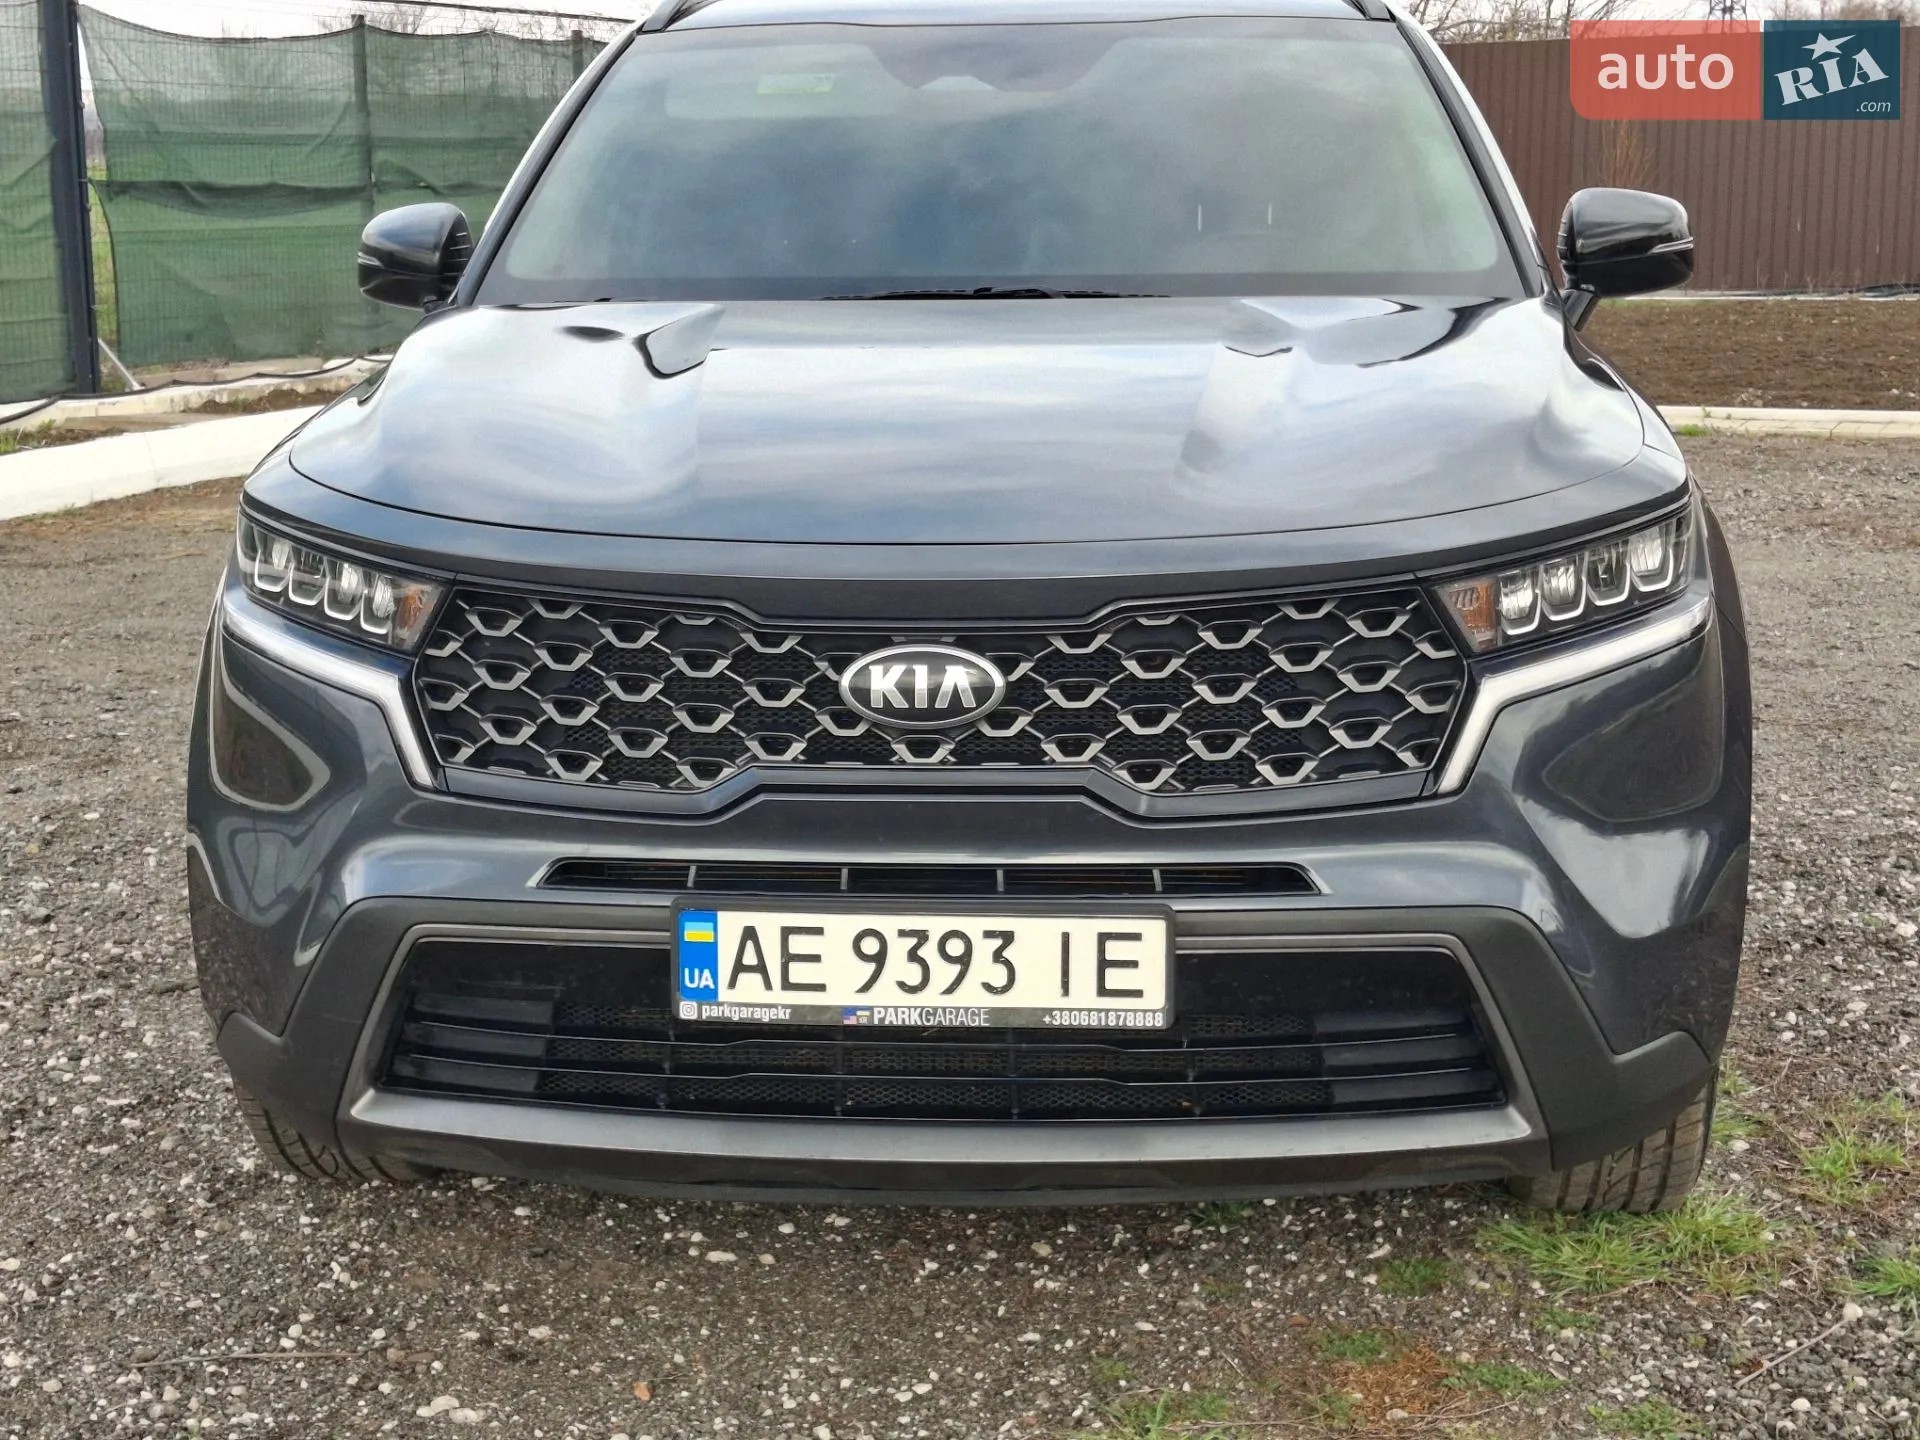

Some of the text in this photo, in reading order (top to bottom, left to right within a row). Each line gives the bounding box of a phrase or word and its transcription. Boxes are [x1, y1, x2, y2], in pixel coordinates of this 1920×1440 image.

[868, 665, 977, 709] KIA
[727, 925, 1145, 998] AE 9393 IE
[684, 968, 715, 989] UA
[701, 1004, 792, 1022] parkgaragekr
[873, 1007, 990, 1026] PARKGARAGE
[1042, 1010, 1163, 1027] +380681878888
